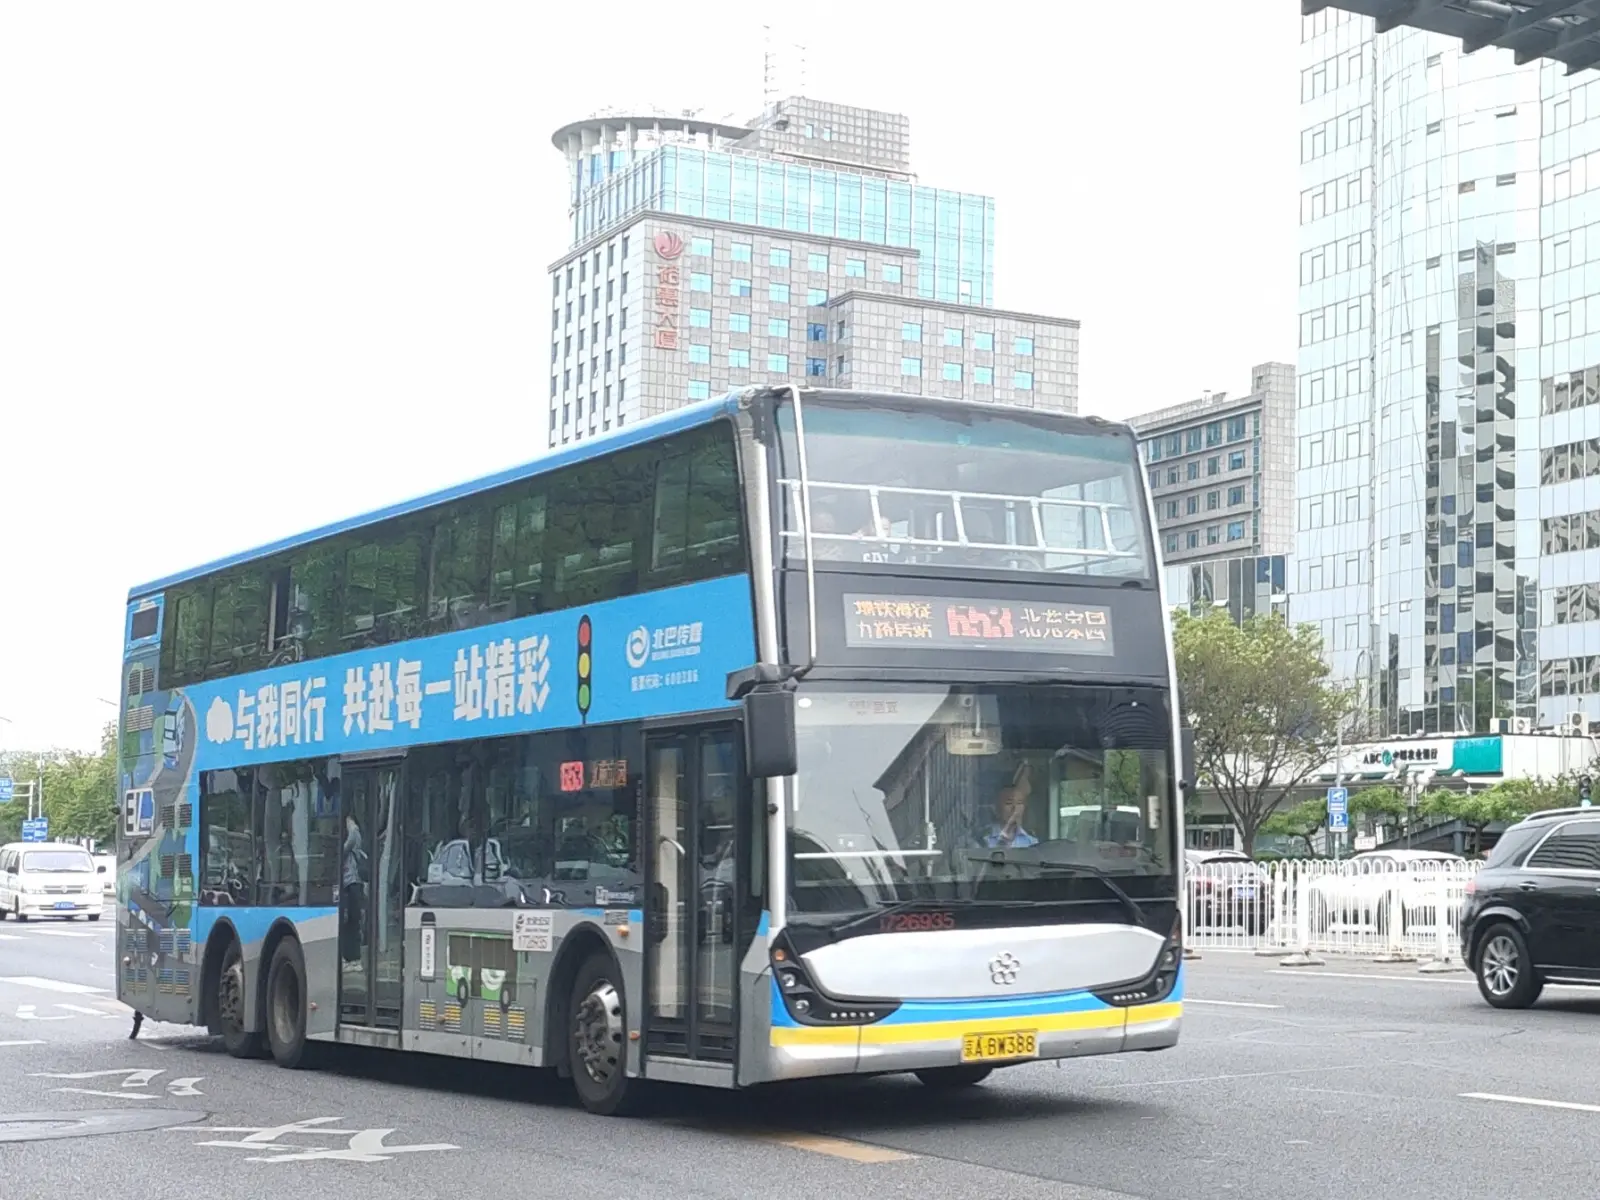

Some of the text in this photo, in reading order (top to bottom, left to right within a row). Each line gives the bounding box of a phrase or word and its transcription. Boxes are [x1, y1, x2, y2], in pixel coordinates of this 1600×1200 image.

[235, 634, 550, 750] 与我同行 共赴每一站精彩
